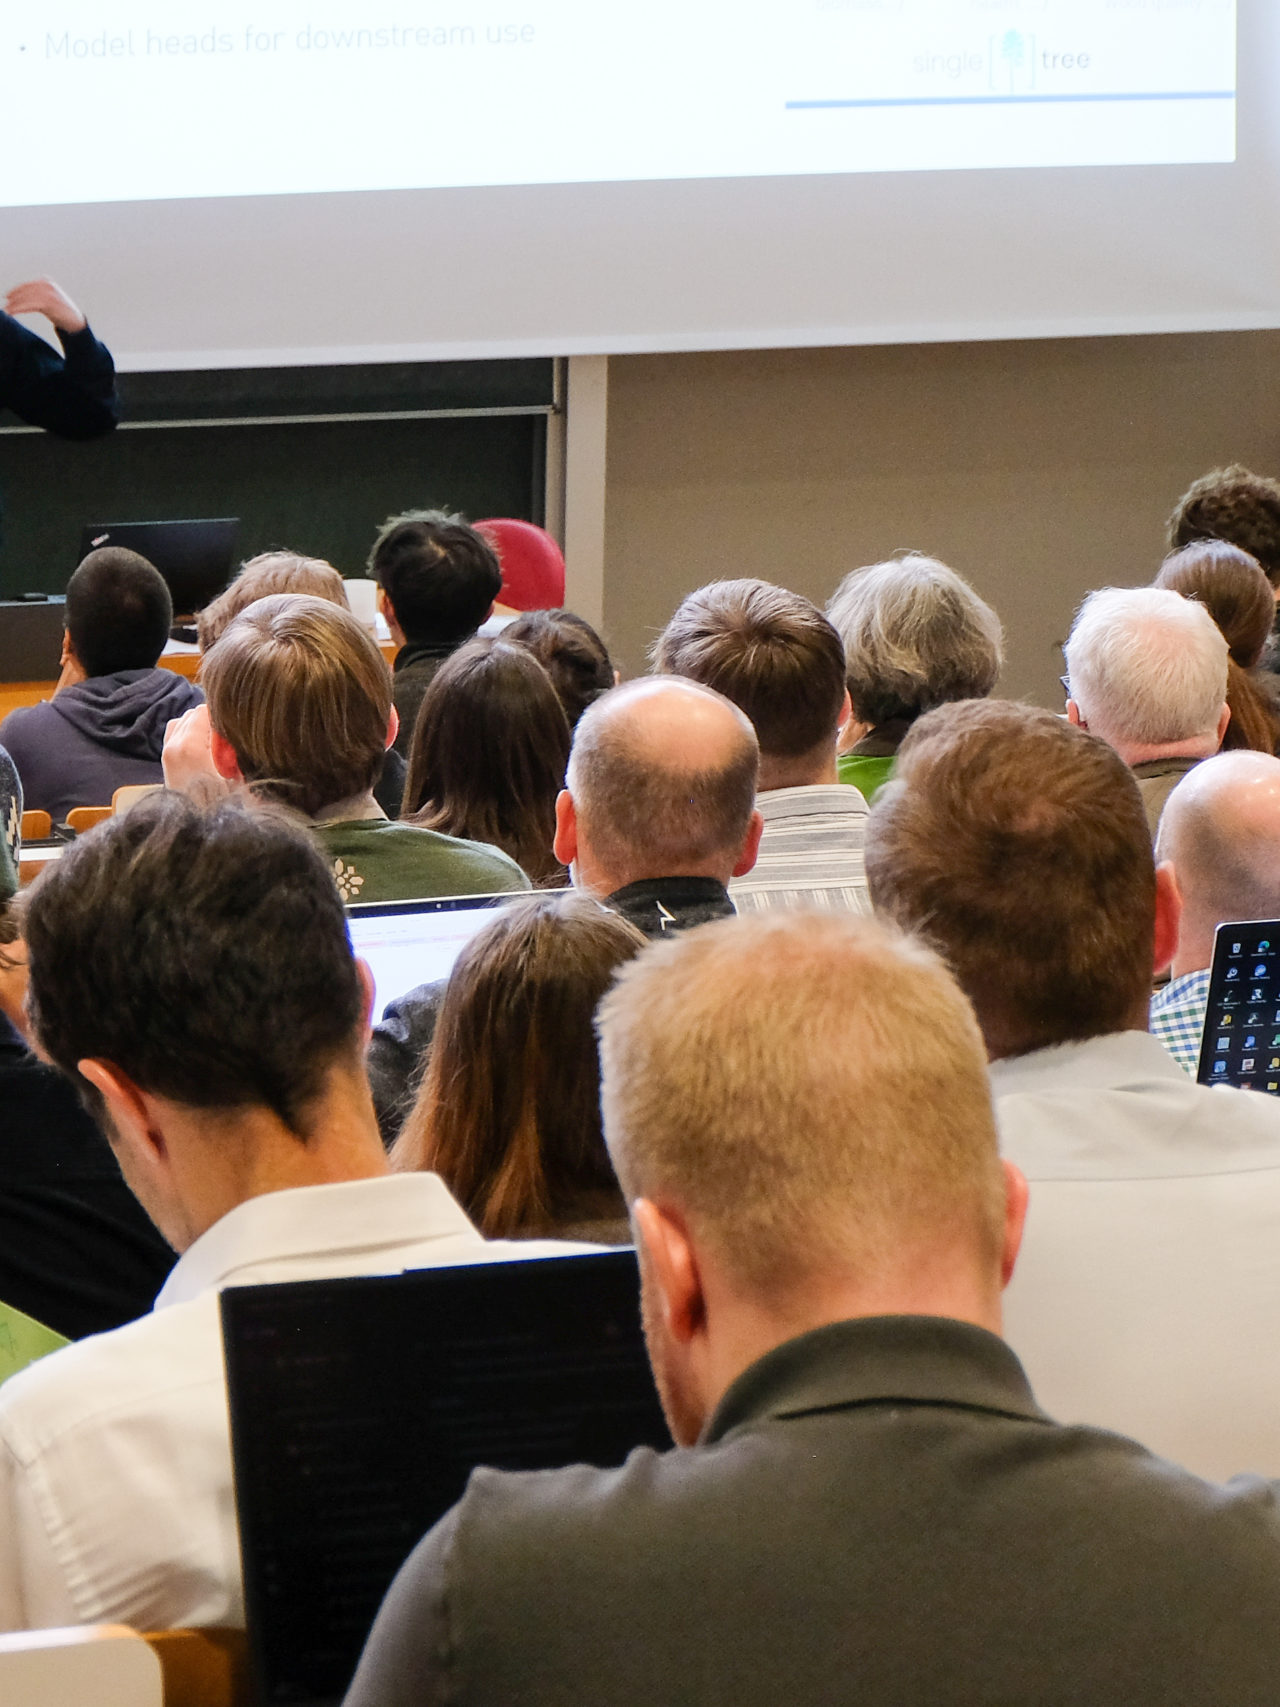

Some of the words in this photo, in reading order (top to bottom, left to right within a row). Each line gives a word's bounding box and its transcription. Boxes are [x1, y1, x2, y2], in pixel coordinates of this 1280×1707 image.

[46, 29, 135, 60] Model
[146, 24, 233, 56] heads
[243, 24, 287, 52] for
[295, 21, 476, 49] downstream
[486, 22, 536, 45] use
[912, 49, 983, 79] single
[1041, 49, 1091, 70] tree
